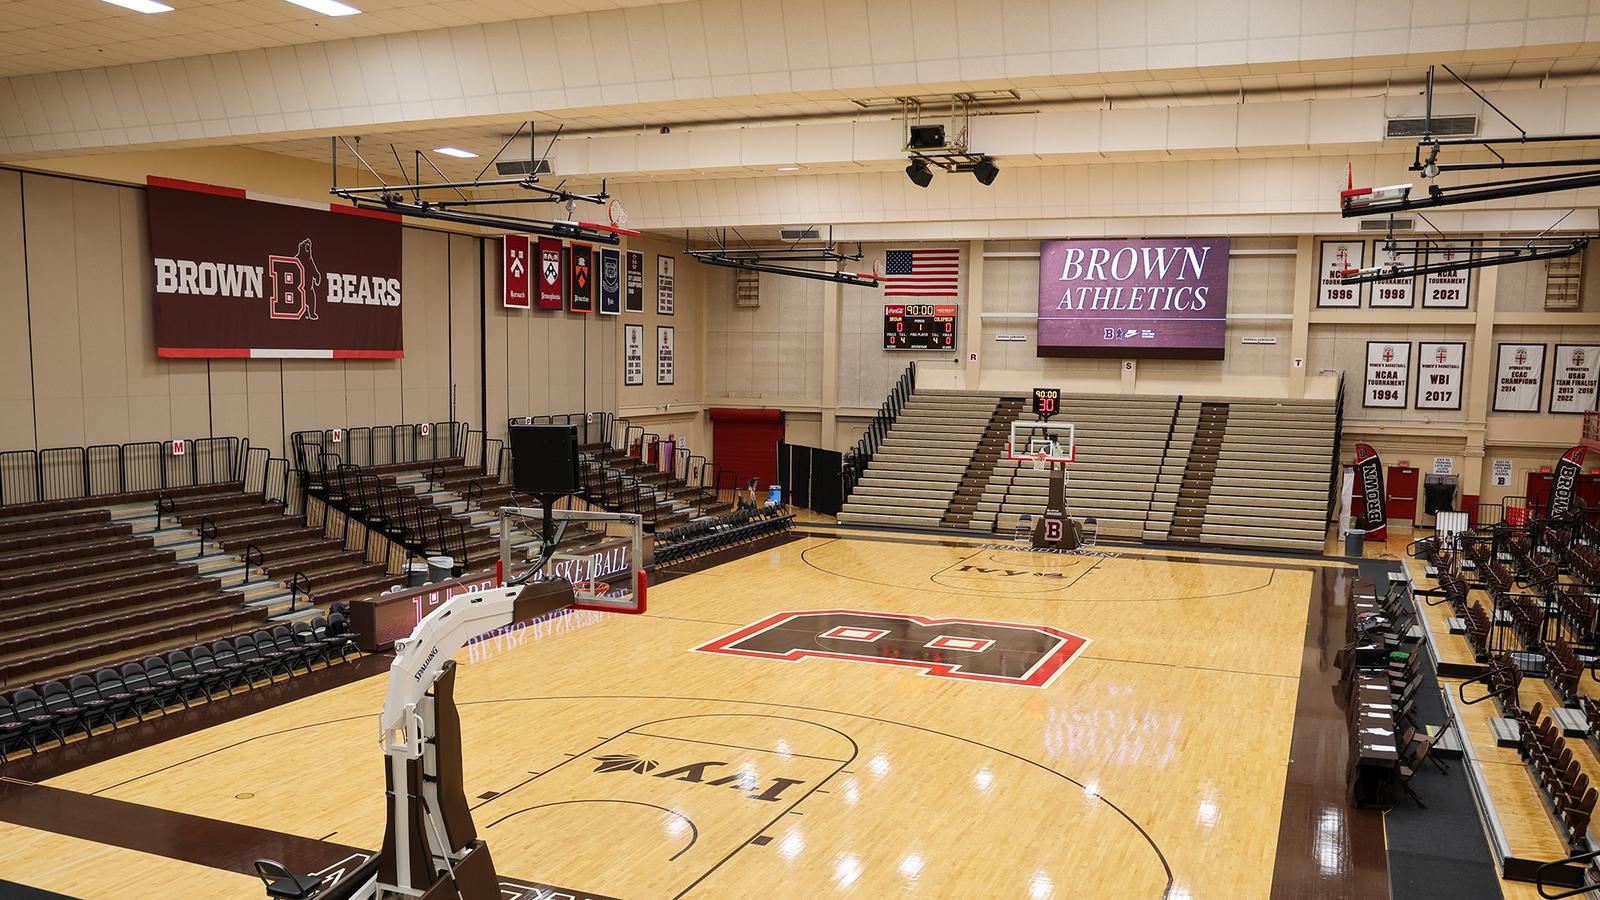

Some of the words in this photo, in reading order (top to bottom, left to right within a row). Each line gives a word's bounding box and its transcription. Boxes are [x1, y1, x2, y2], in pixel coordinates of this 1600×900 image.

[1059, 246, 1211, 281] BROWN
[154, 258, 264, 298] BROWN
[268, 255, 306, 319] B
[326, 272, 400, 306] BEARS
[1056, 286, 1210, 311] ATHLETICS
[1328, 290, 1352, 299] 1996
[1380, 289, 1405, 299] 1998
[1433, 290, 1459, 300] 2021
[907, 305, 933, 316] 90:00
[897, 322, 903, 332] 0
[945, 322, 952, 333] 0
[1104, 328, 1115, 339] B
[1375, 371, 1398, 379] NCAA
[1430, 374, 1449, 384] WBI
[1373, 390, 1398, 400] 1994
[1425, 391, 1452, 401] 2017
[1039, 399, 1054, 411] 30
[335, 431, 340, 440] N
[174, 442, 184, 452] M
[1363, 463, 1382, 523] BROWN
[1044, 519, 1062, 541] B
[688, 608, 1094, 688] B
[414, 646, 438, 682] SPALDING
[653, 761, 805, 802] Ivy
